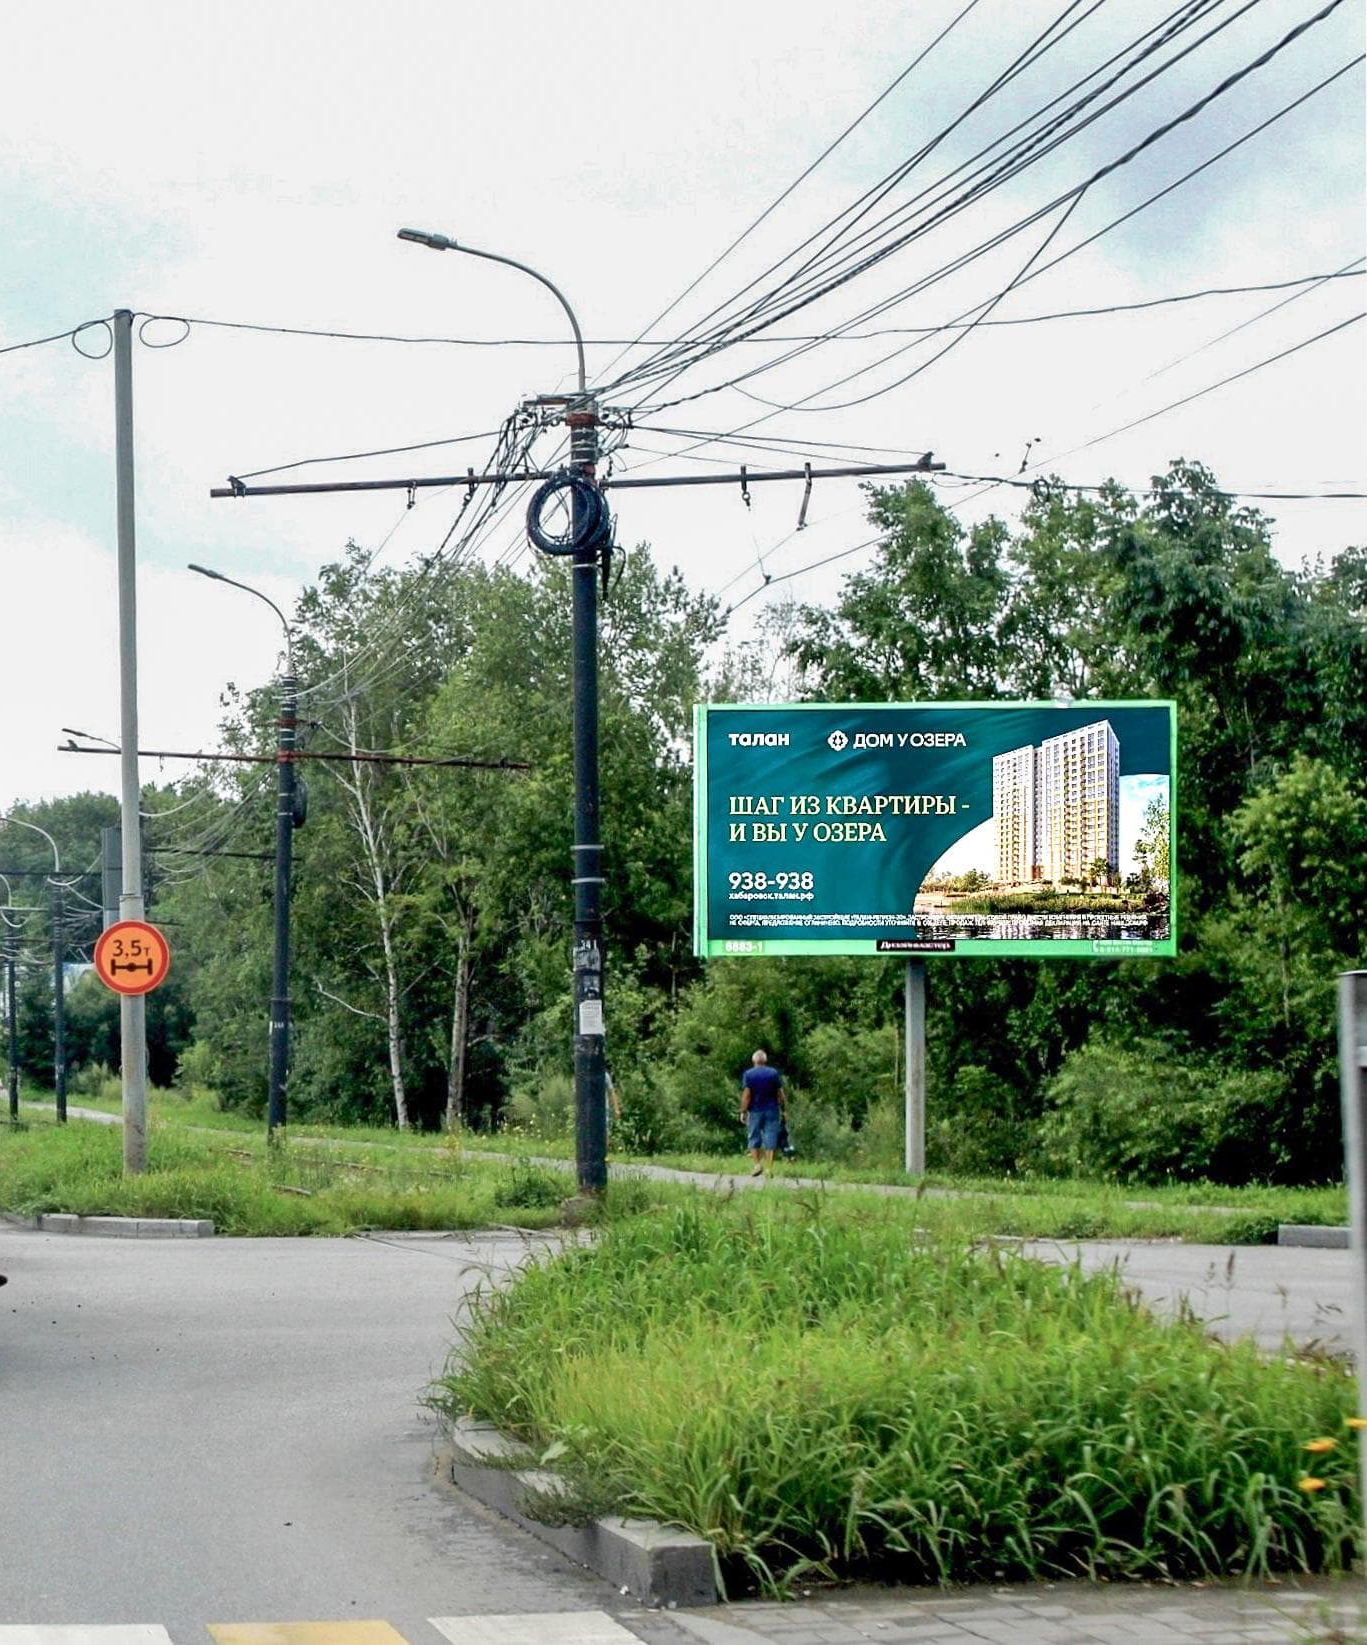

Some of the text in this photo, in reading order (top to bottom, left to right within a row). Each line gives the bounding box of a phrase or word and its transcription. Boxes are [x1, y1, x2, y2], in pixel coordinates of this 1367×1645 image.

[728, 733, 790, 746] талан
[853, 733, 967, 749] ДОМ У ОЗЕРА
[729, 796, 785, 815] ШАГ
[789, 796, 821, 815] ИЗ
[825, 796, 956, 815] КВАРТИРЫ
[729, 823, 887, 842] И ВЫ У ОЗЕРА
[728, 872, 814, 890] 938-938
